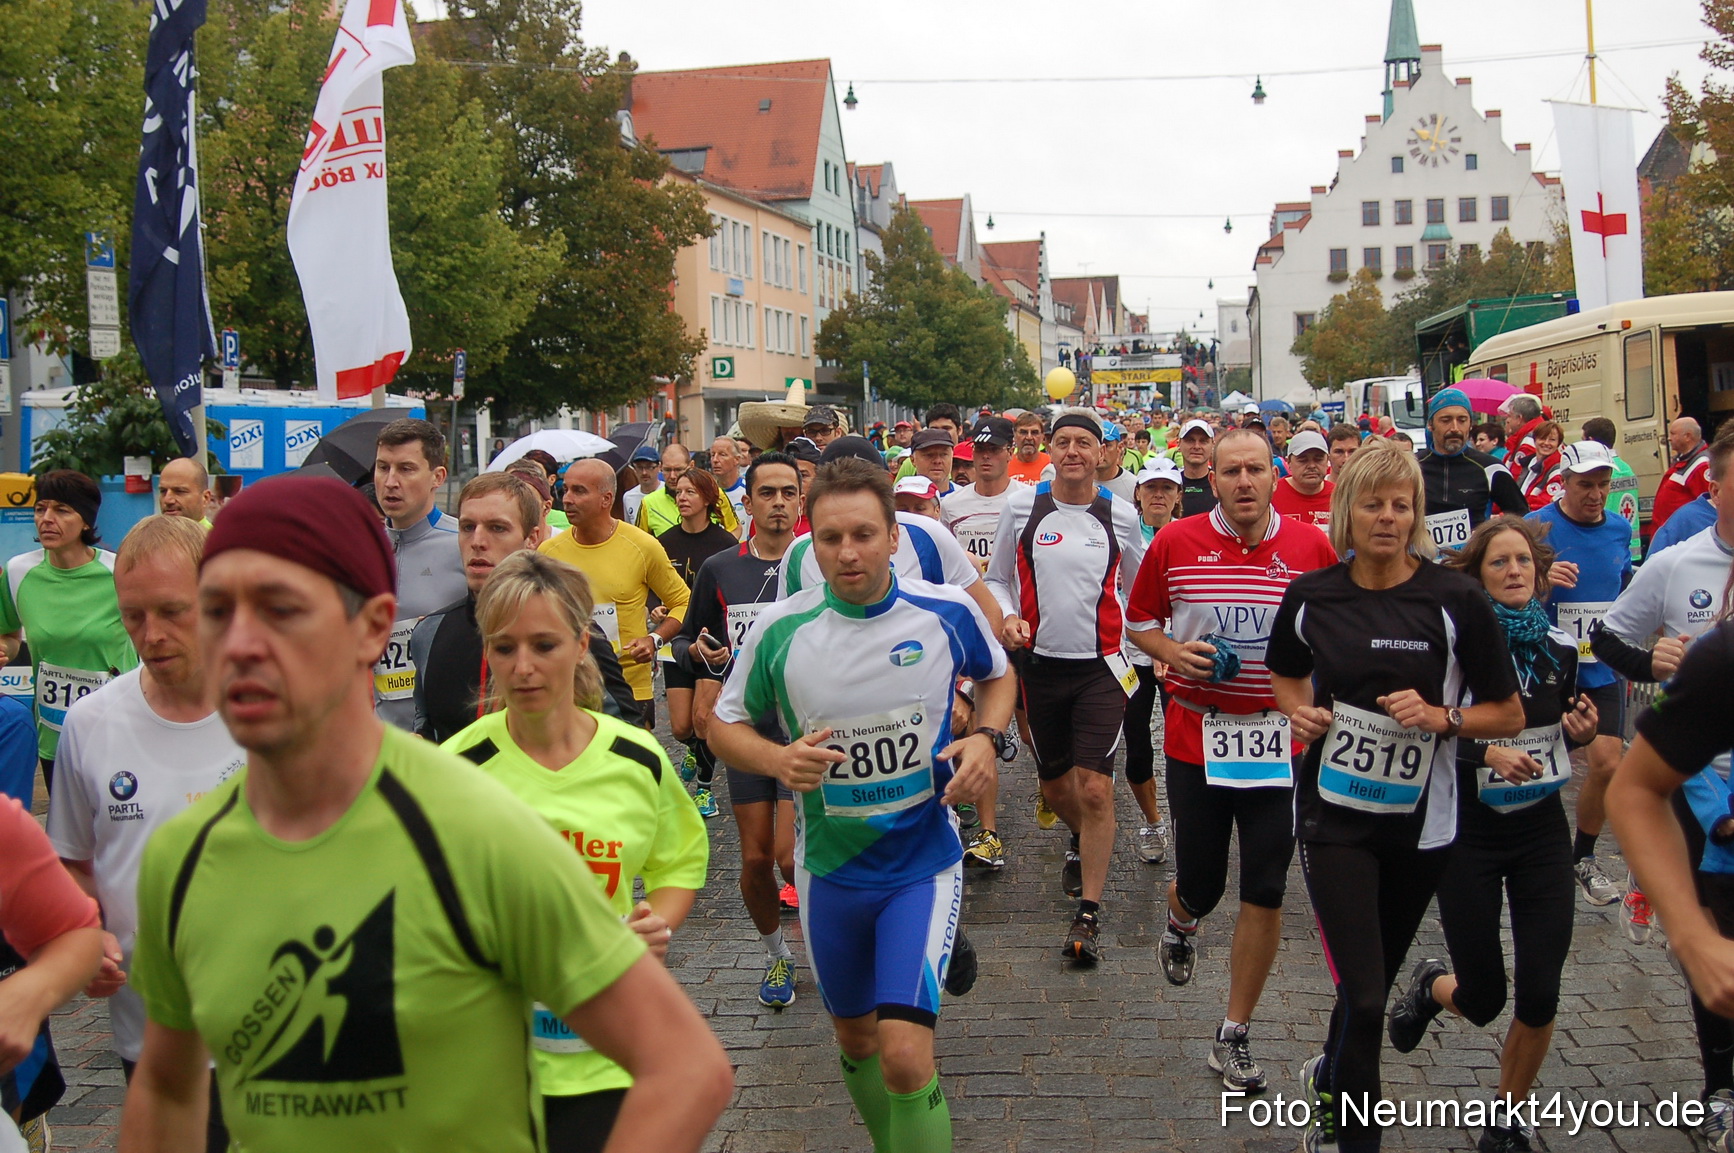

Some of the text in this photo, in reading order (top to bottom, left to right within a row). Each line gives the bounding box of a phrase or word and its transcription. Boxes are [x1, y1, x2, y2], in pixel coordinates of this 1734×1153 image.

[226, 335, 236, 363] P
[715, 359, 731, 376] D
[1547, 352, 1597, 379] Bayerisches
[1120, 372, 1152, 381] START
[1547, 382, 1571, 401] Rotes
[1039, 533, 1057, 541] tkn
[1427, 522, 1467, 545] 078
[967, 538, 994, 558] 40
[1213, 606, 1268, 634] VPV
[1559, 607, 1582, 615] PARTL
[1380, 639, 1429, 651] PFLEIDERER
[0, 676, 21, 686] SU
[40, 668, 102, 686] PARTL Neumarkt
[852, 719, 907, 738] Neumarkt
[1235, 719, 1275, 727] Neumarkt
[1333, 711, 1417, 740] PARTL Neumarkt
[1212, 730, 1283, 758] 3134
[1511, 735, 1553, 746] Neumarkt
[825, 732, 921, 780] 2802
[1330, 730, 1422, 780] 2519
[851, 783, 905, 804] Steffen
[1349, 780, 1386, 800] Heidi
[1504, 786, 1547, 803] GISELA
[108, 803, 143, 815] PARTL
[110, 813, 144, 822] Neumarkt
[224, 966, 298, 1066] GOSSEN
[246, 1086, 408, 1117] METRAWATT
